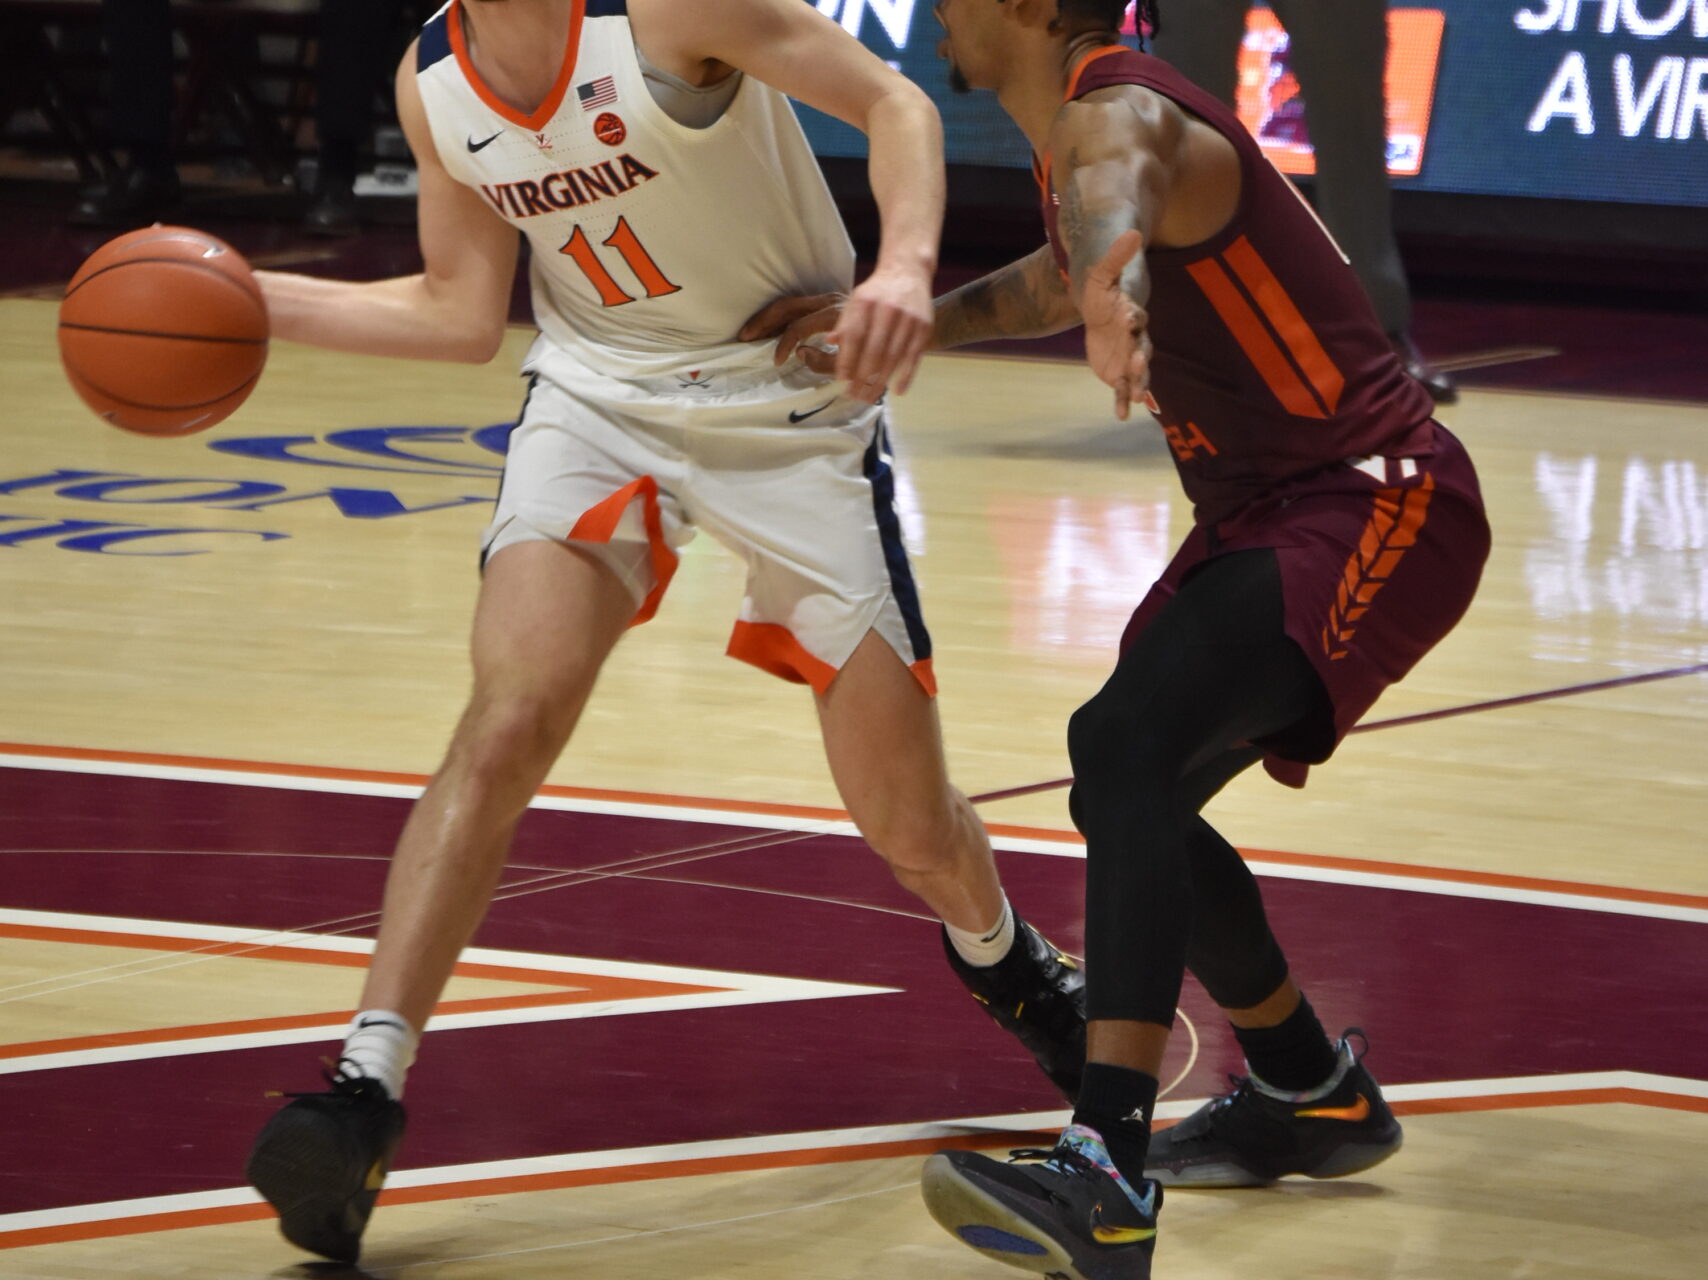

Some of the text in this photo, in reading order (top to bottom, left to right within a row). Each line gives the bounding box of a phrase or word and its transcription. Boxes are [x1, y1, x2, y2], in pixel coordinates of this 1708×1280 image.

[1525, 50, 1595, 136] A
[481, 153, 661, 218] VIRGINIA
[558, 215, 683, 307] 11
